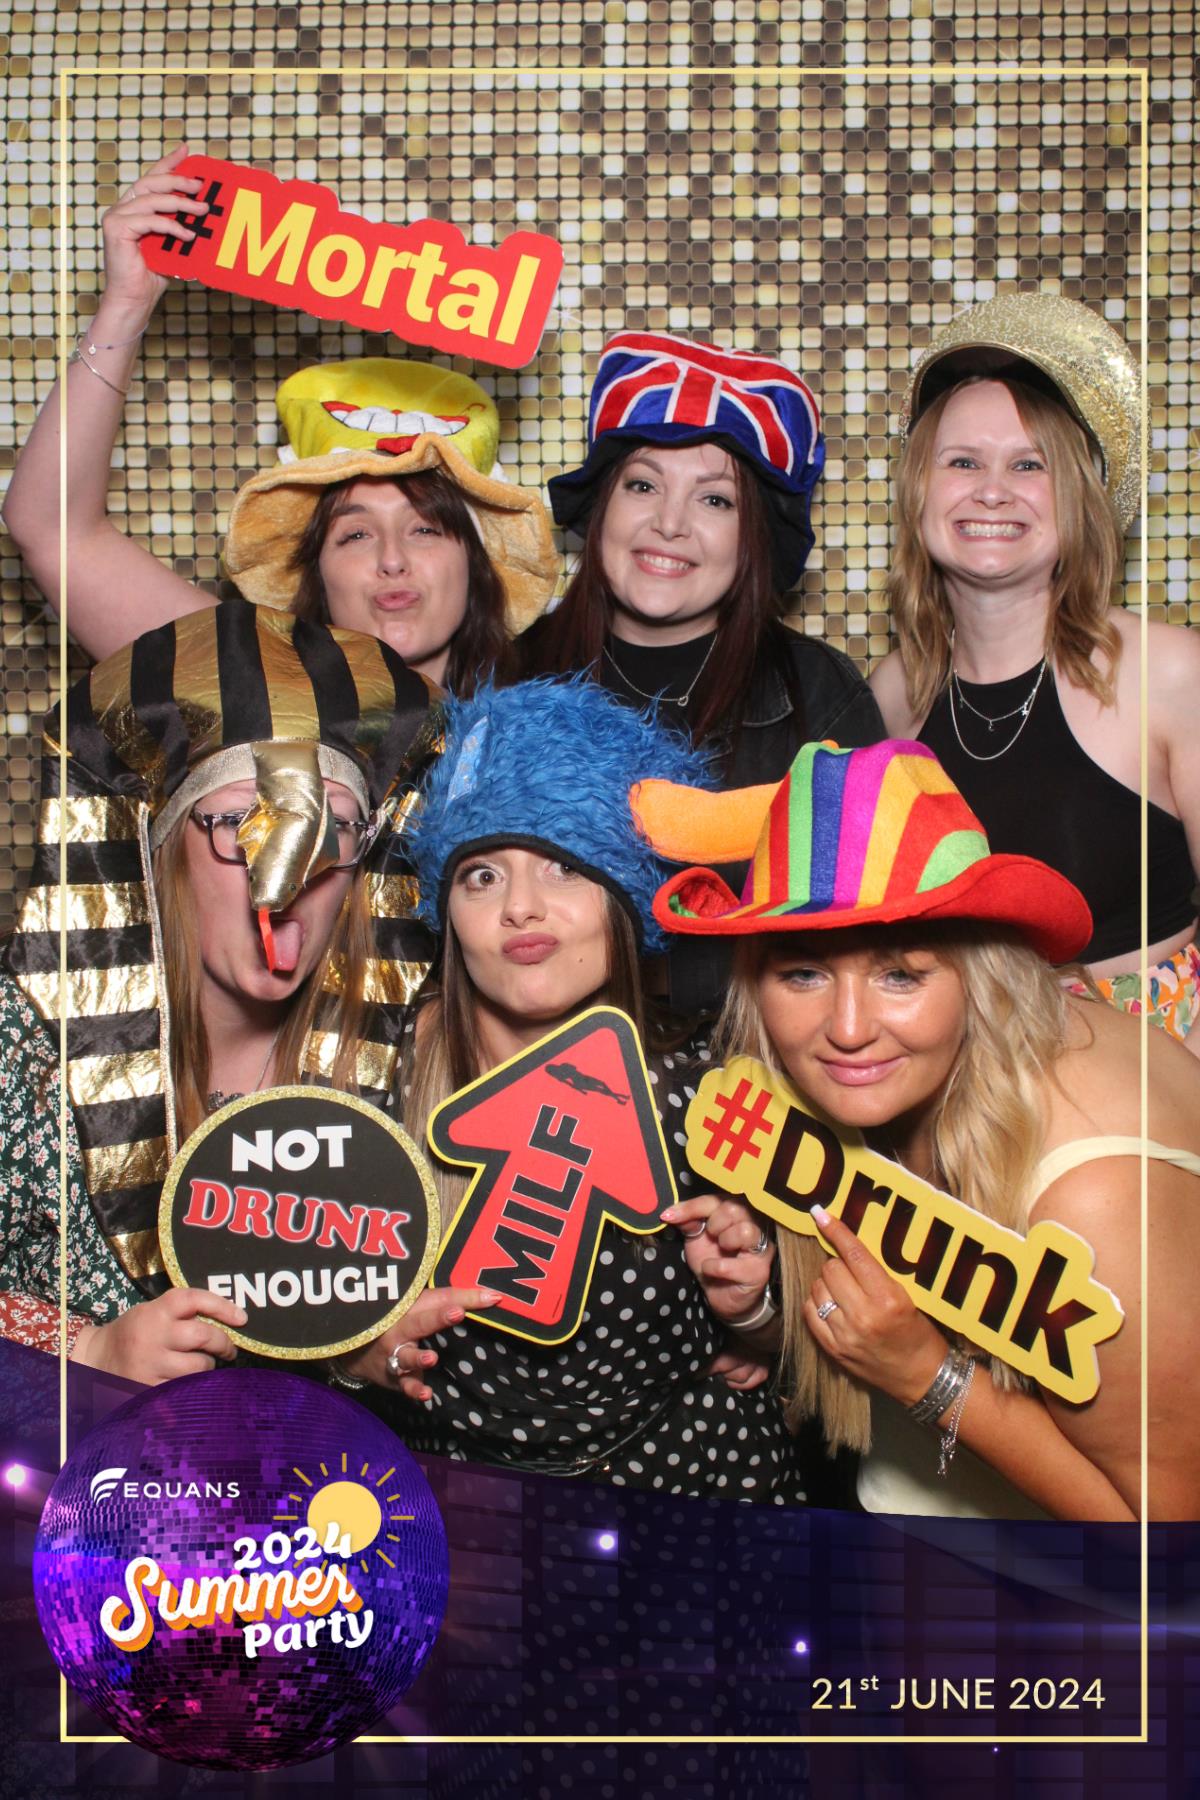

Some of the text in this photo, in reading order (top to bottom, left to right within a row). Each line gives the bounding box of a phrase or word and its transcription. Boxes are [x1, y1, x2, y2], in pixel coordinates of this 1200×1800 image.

[160, 177, 541, 345] #Mortal
[231, 1125, 352, 1172] NOT
[476, 1103, 593, 1306] MILF
[182, 1178, 411, 1260] DRUNK
[702, 1078, 1098, 1380] #Drunk
[207, 1264, 399, 1309] ENOUGH
